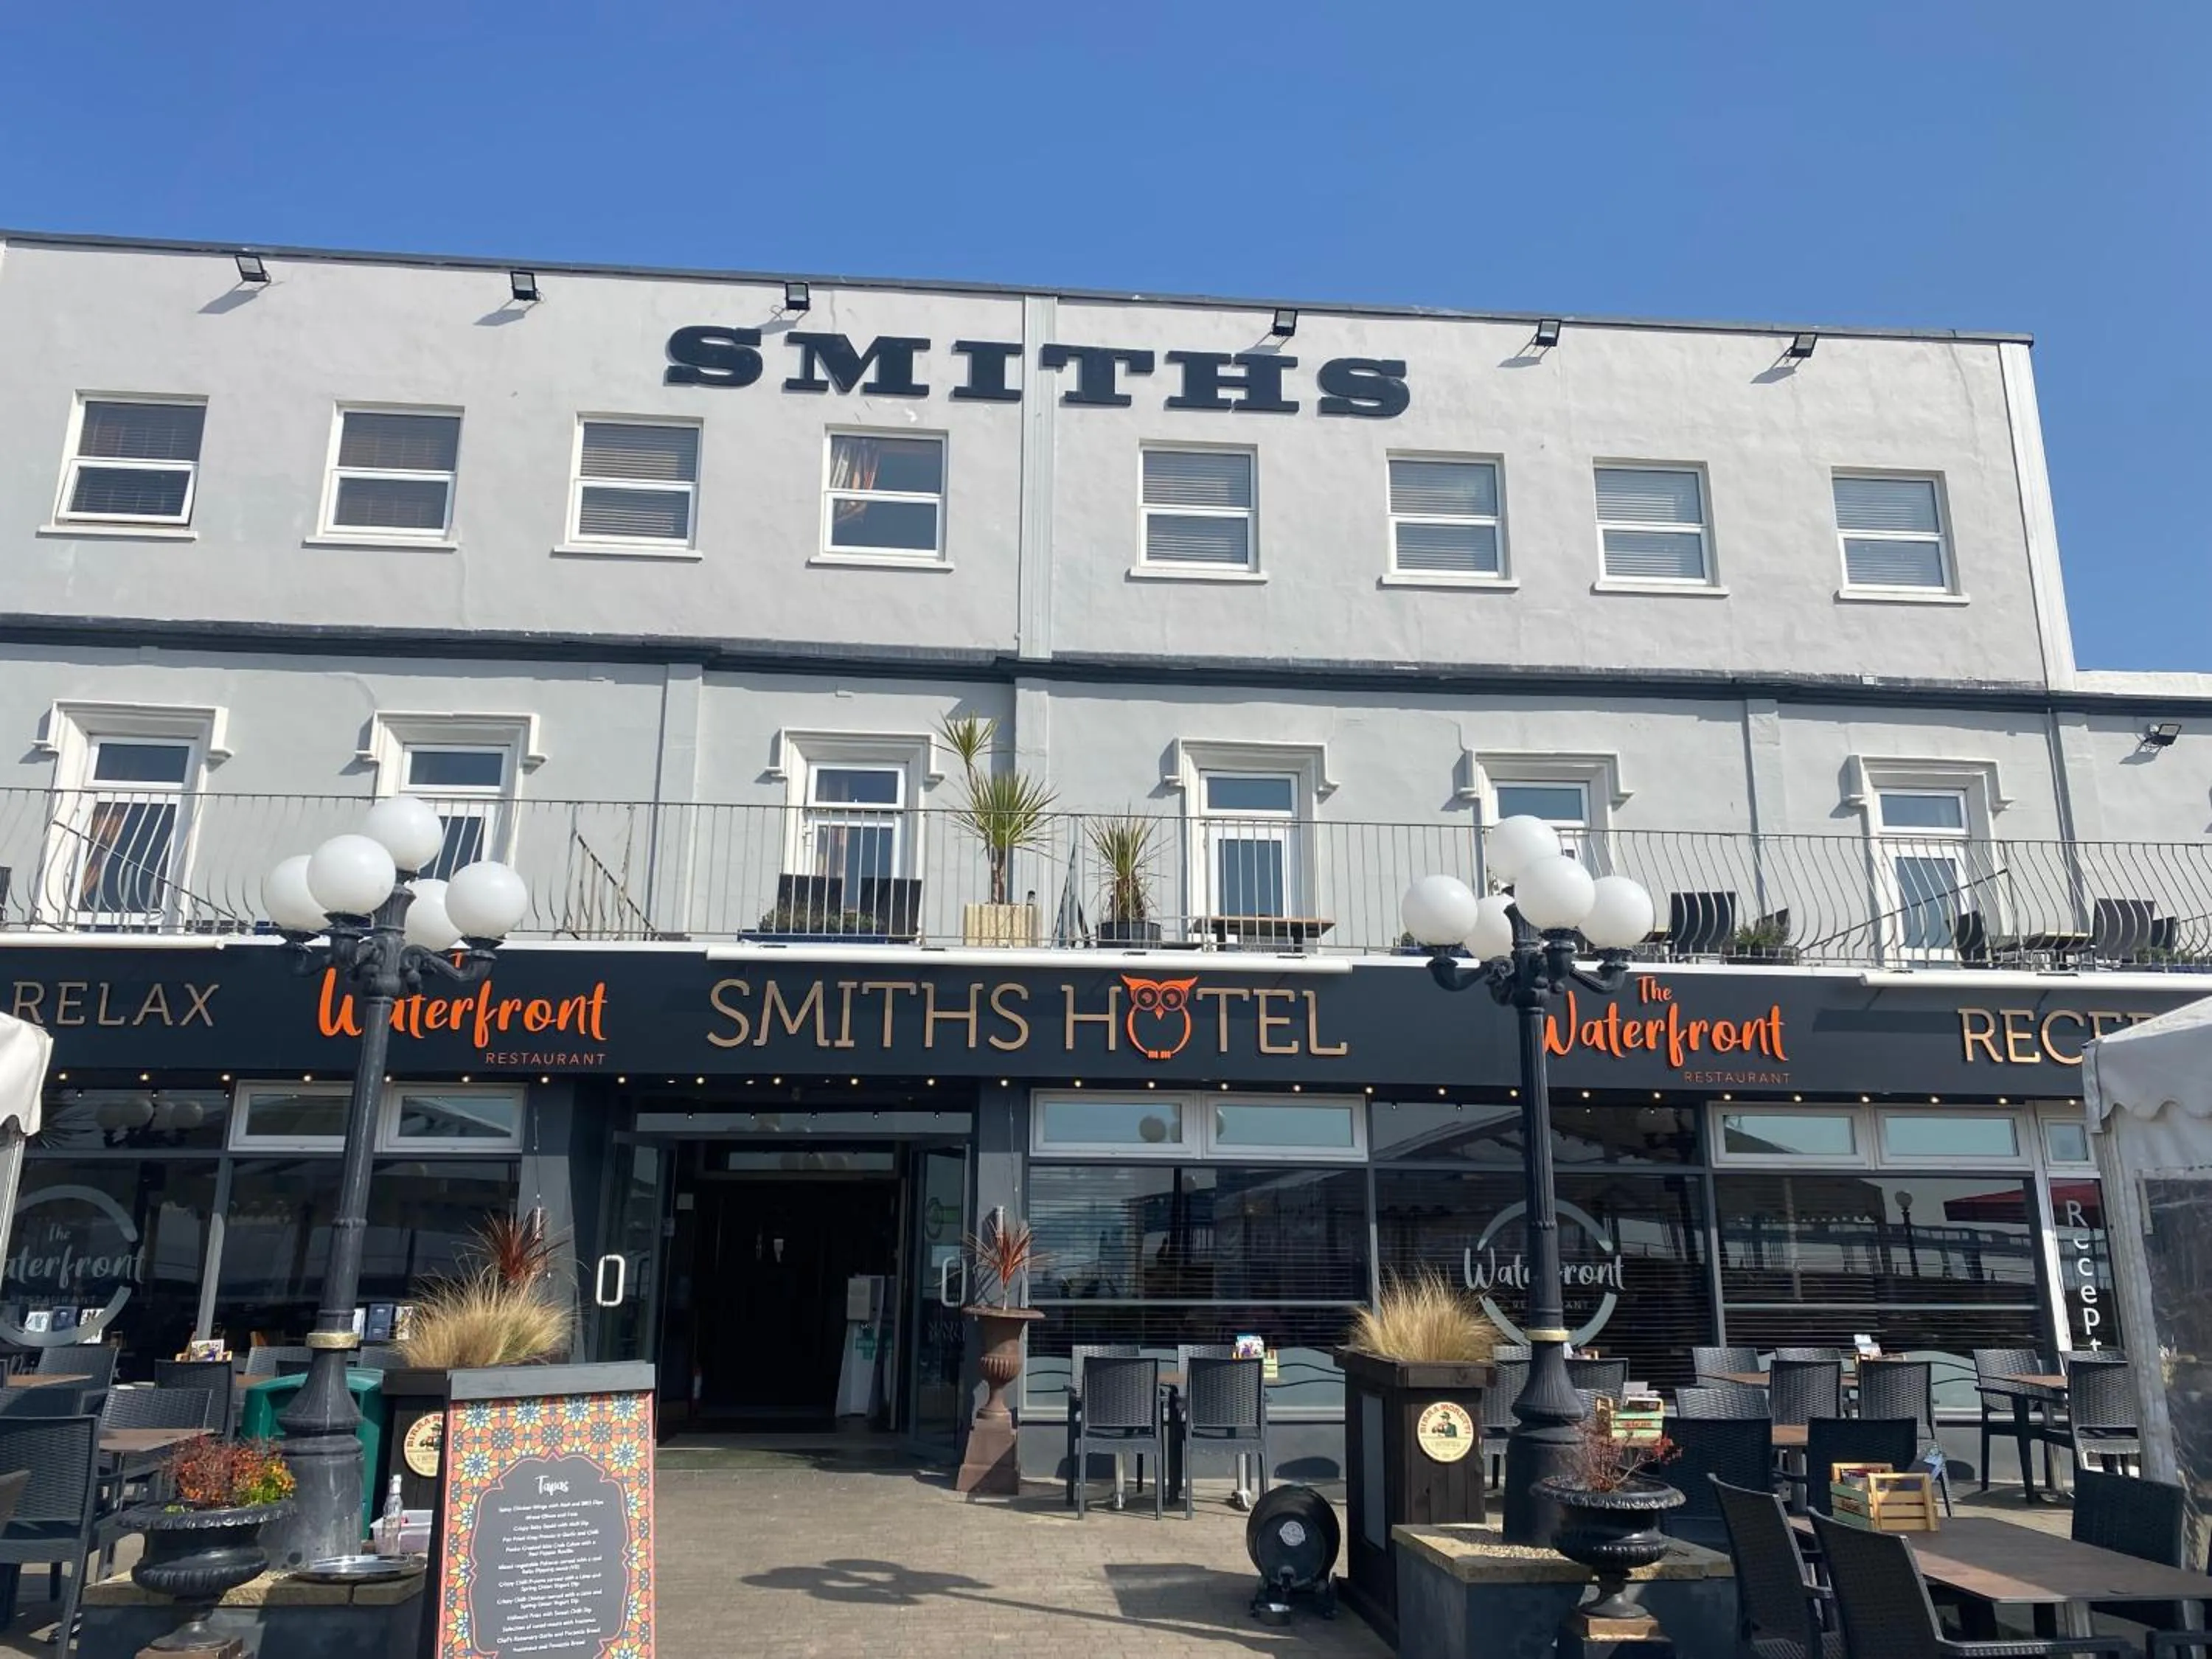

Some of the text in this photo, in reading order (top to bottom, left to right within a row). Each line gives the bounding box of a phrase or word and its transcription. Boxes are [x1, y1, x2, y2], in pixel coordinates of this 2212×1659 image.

[664, 325, 1411, 417] SMITHS
[1636, 975, 1672, 1004] The
[13, 981, 220, 1027] RELAX
[707, 973, 1347, 1059] SMITHS HOTEL
[485, 1052, 606, 1065] RESTAURANT
[1684, 1071, 1791, 1085] RESTAURANT
[49, 1223, 72, 1242] The
[535, 1475, 569, 1496] Tapas
